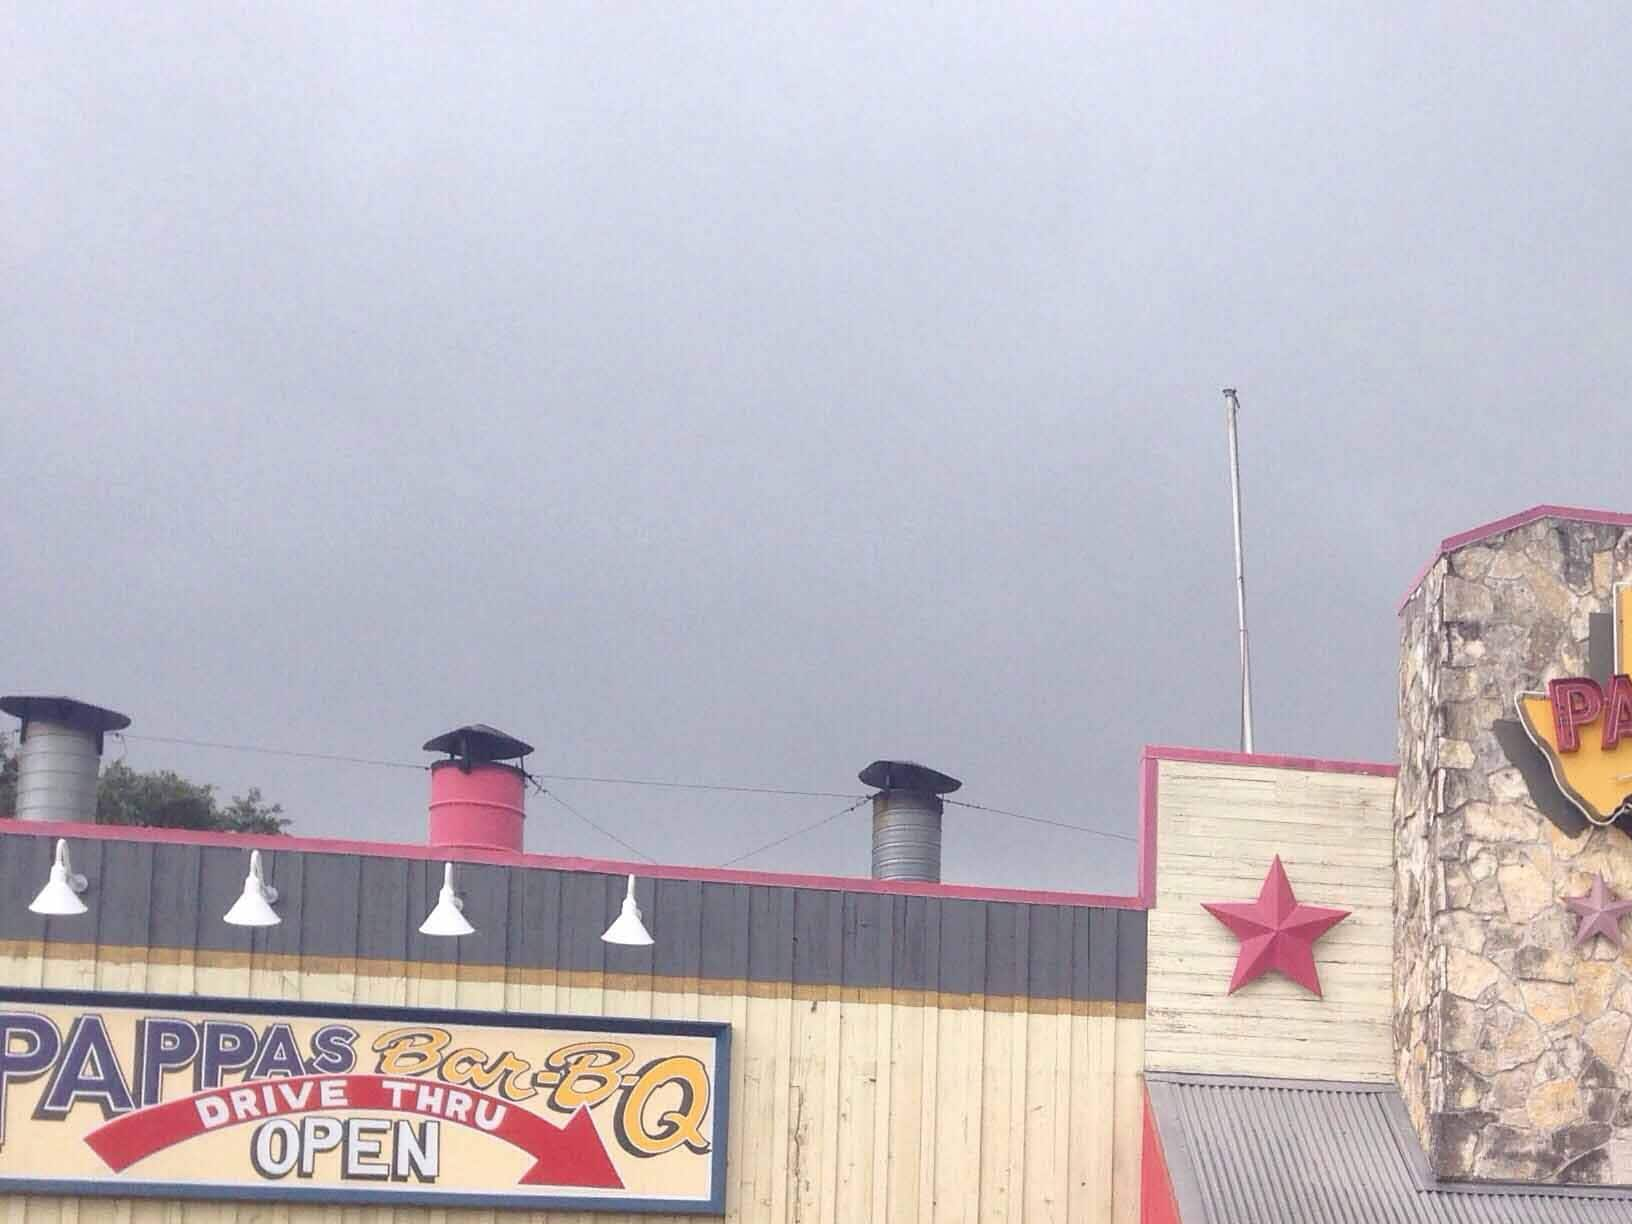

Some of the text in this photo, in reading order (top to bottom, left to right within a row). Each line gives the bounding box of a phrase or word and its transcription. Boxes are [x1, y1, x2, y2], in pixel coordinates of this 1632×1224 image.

[0, 1011, 712, 1158] PAPPAS Bar-B-Q
[195, 1079, 507, 1131] DRIVE THRU
[250, 1116, 440, 1185] OPEN
